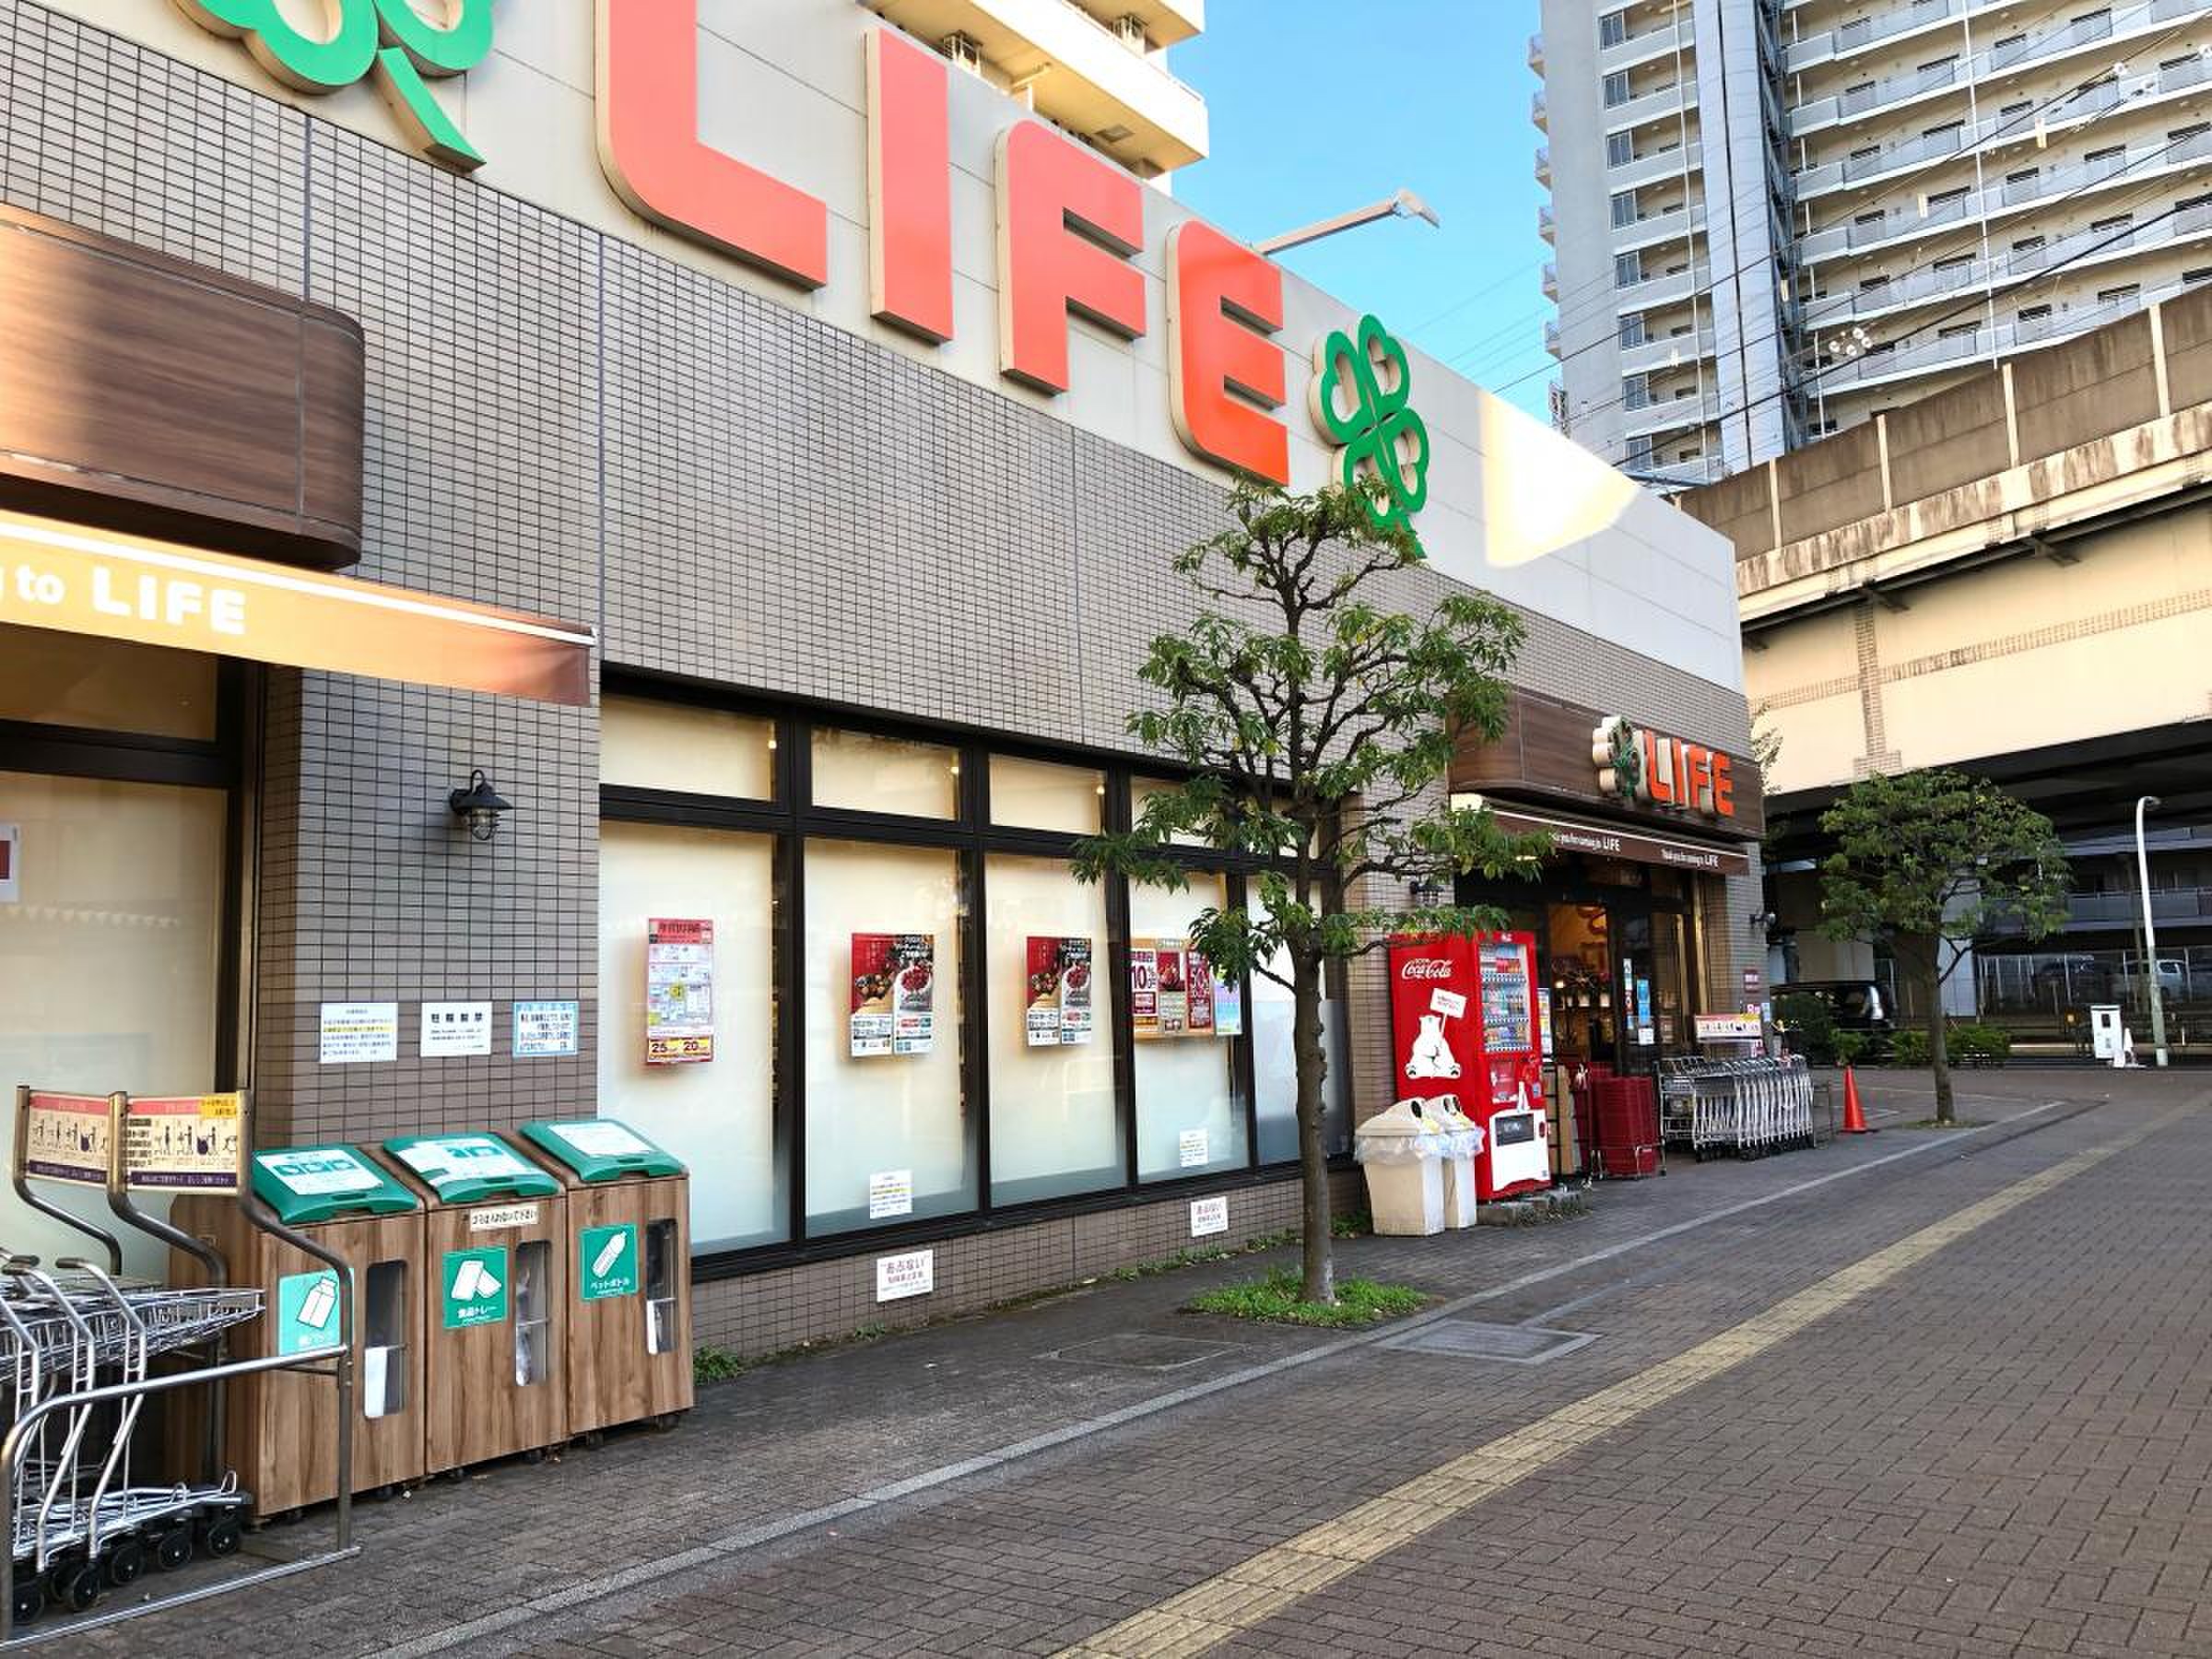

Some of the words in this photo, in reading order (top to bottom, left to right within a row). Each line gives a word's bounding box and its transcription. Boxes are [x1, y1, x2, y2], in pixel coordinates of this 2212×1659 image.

[594, 0, 1289, 488] LIFE
[15, 564, 65, 605] to
[92, 565, 248, 636] LIFE
[1641, 727, 1735, 818] LIFE
[1401, 958, 1453, 981] Coca-Cola
